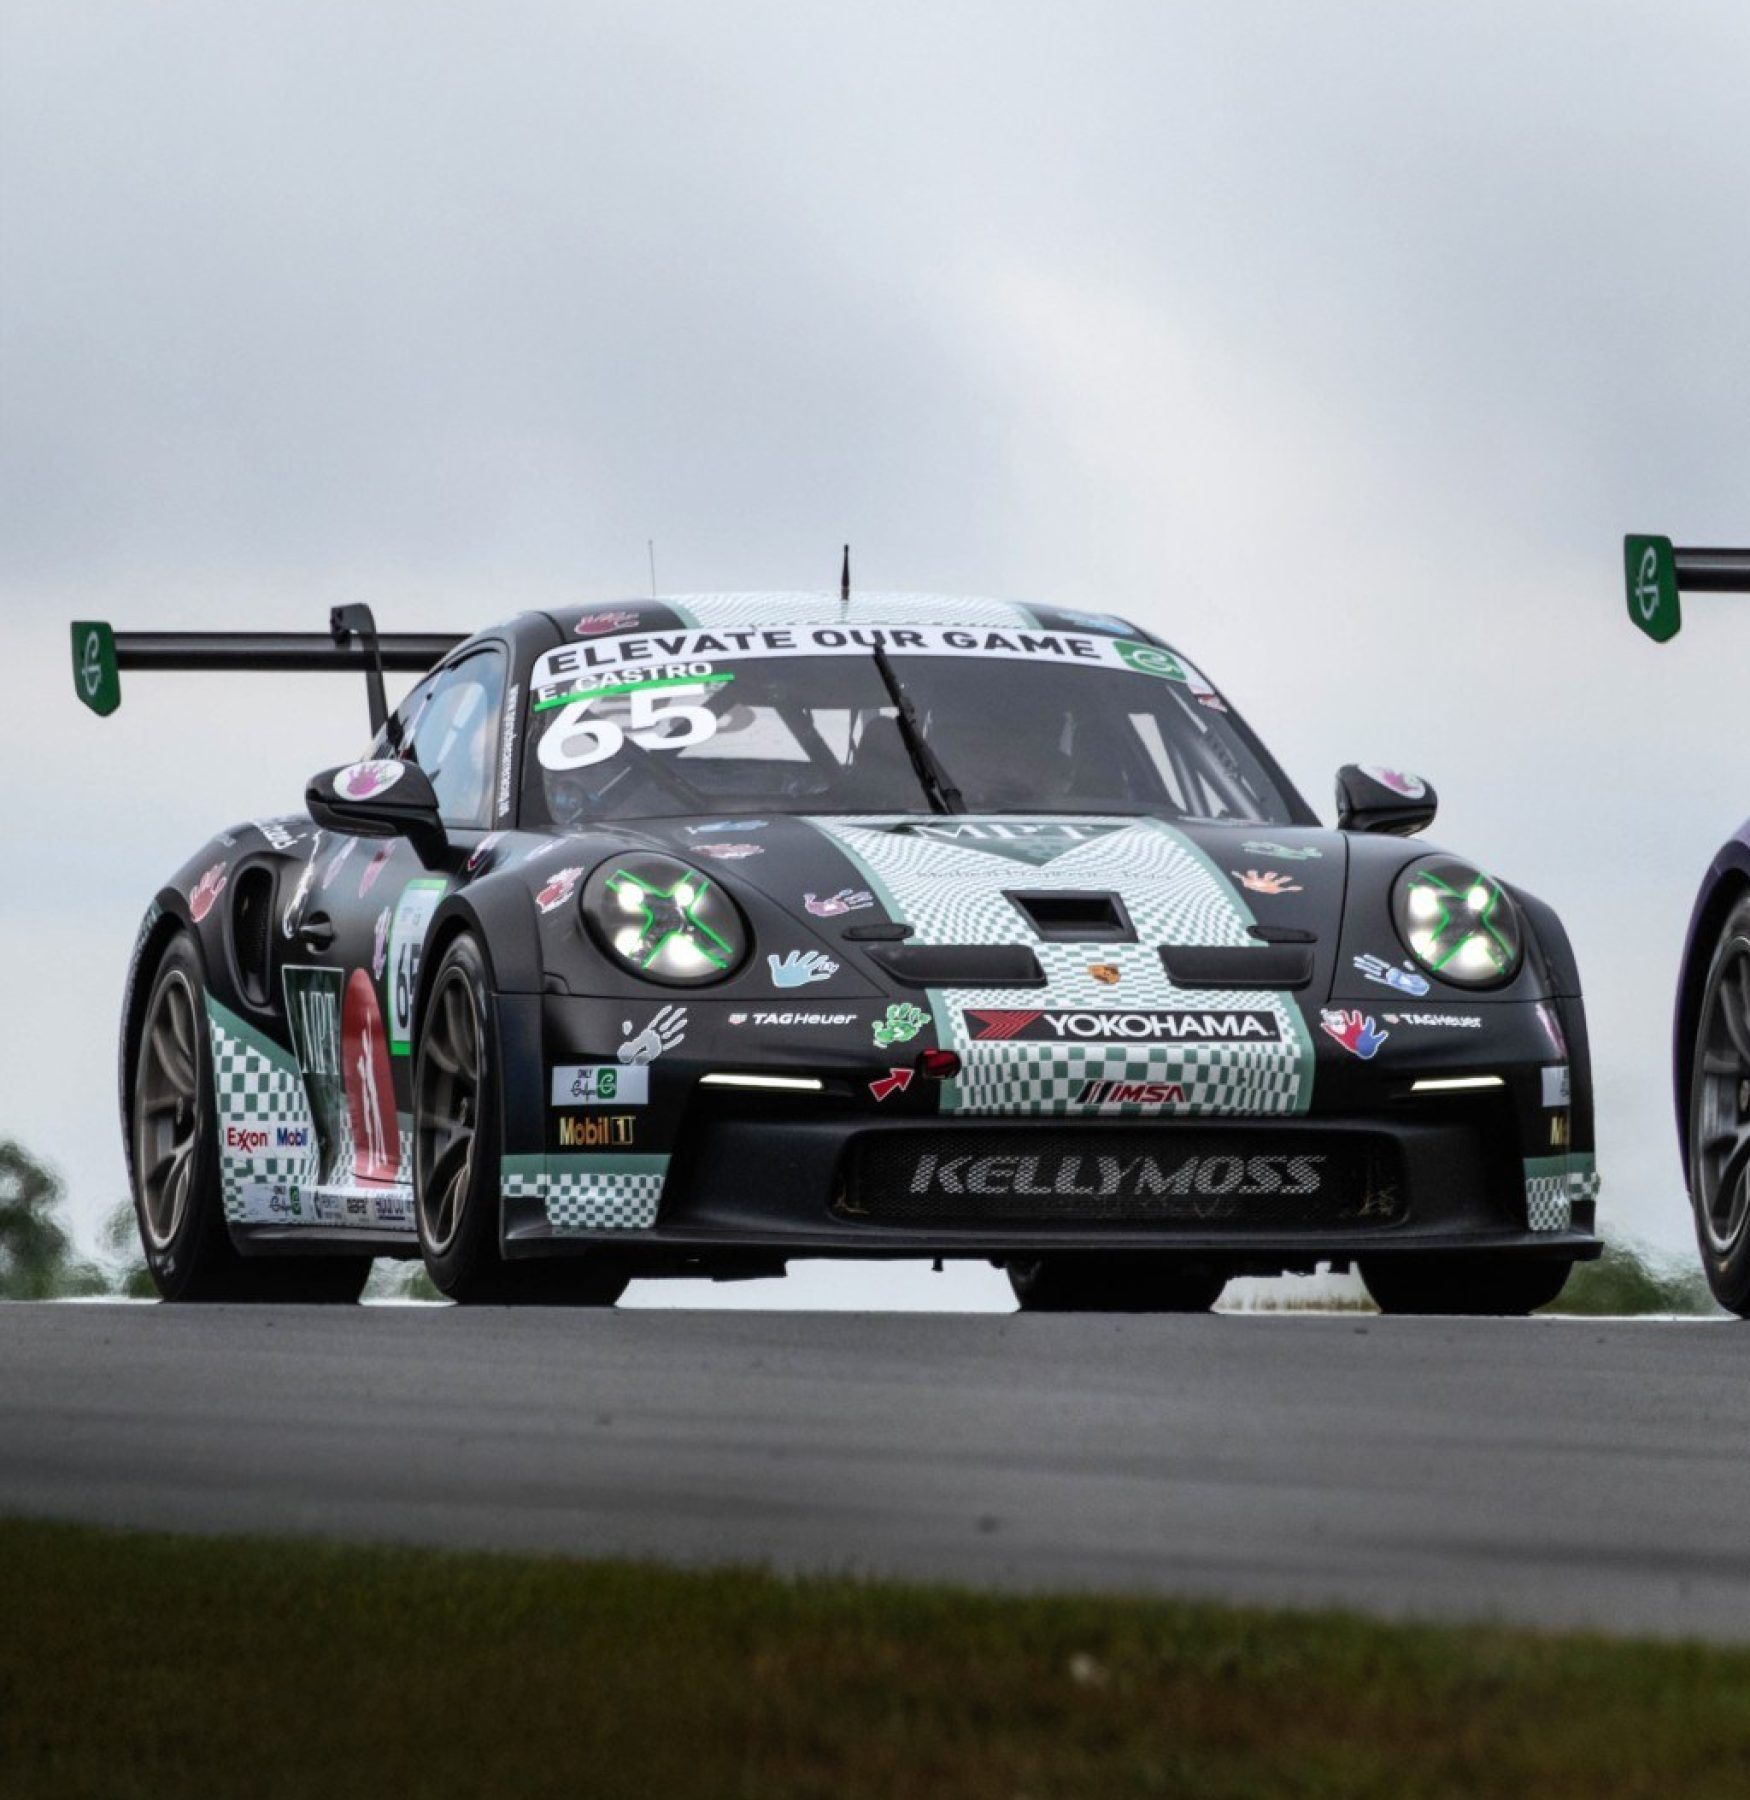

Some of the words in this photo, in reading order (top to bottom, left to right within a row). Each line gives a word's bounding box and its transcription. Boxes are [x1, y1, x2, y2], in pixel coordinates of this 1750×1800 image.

[547, 630, 797, 676] ELEVATE
[812, 627, 930, 649] OUR
[944, 630, 1101, 661] GAME
[538, 686, 568, 703] E.
[576, 661, 713, 691] CASTRO
[537, 683, 717, 771] 65
[1043, 1013, 1268, 1037] YOKOHAMA
[1108, 1082, 1186, 1103] IMSA
[227, 1127, 269, 1152] Exxon
[276, 1127, 309, 1147] Mobil
[559, 1115, 609, 1146] Mobil
